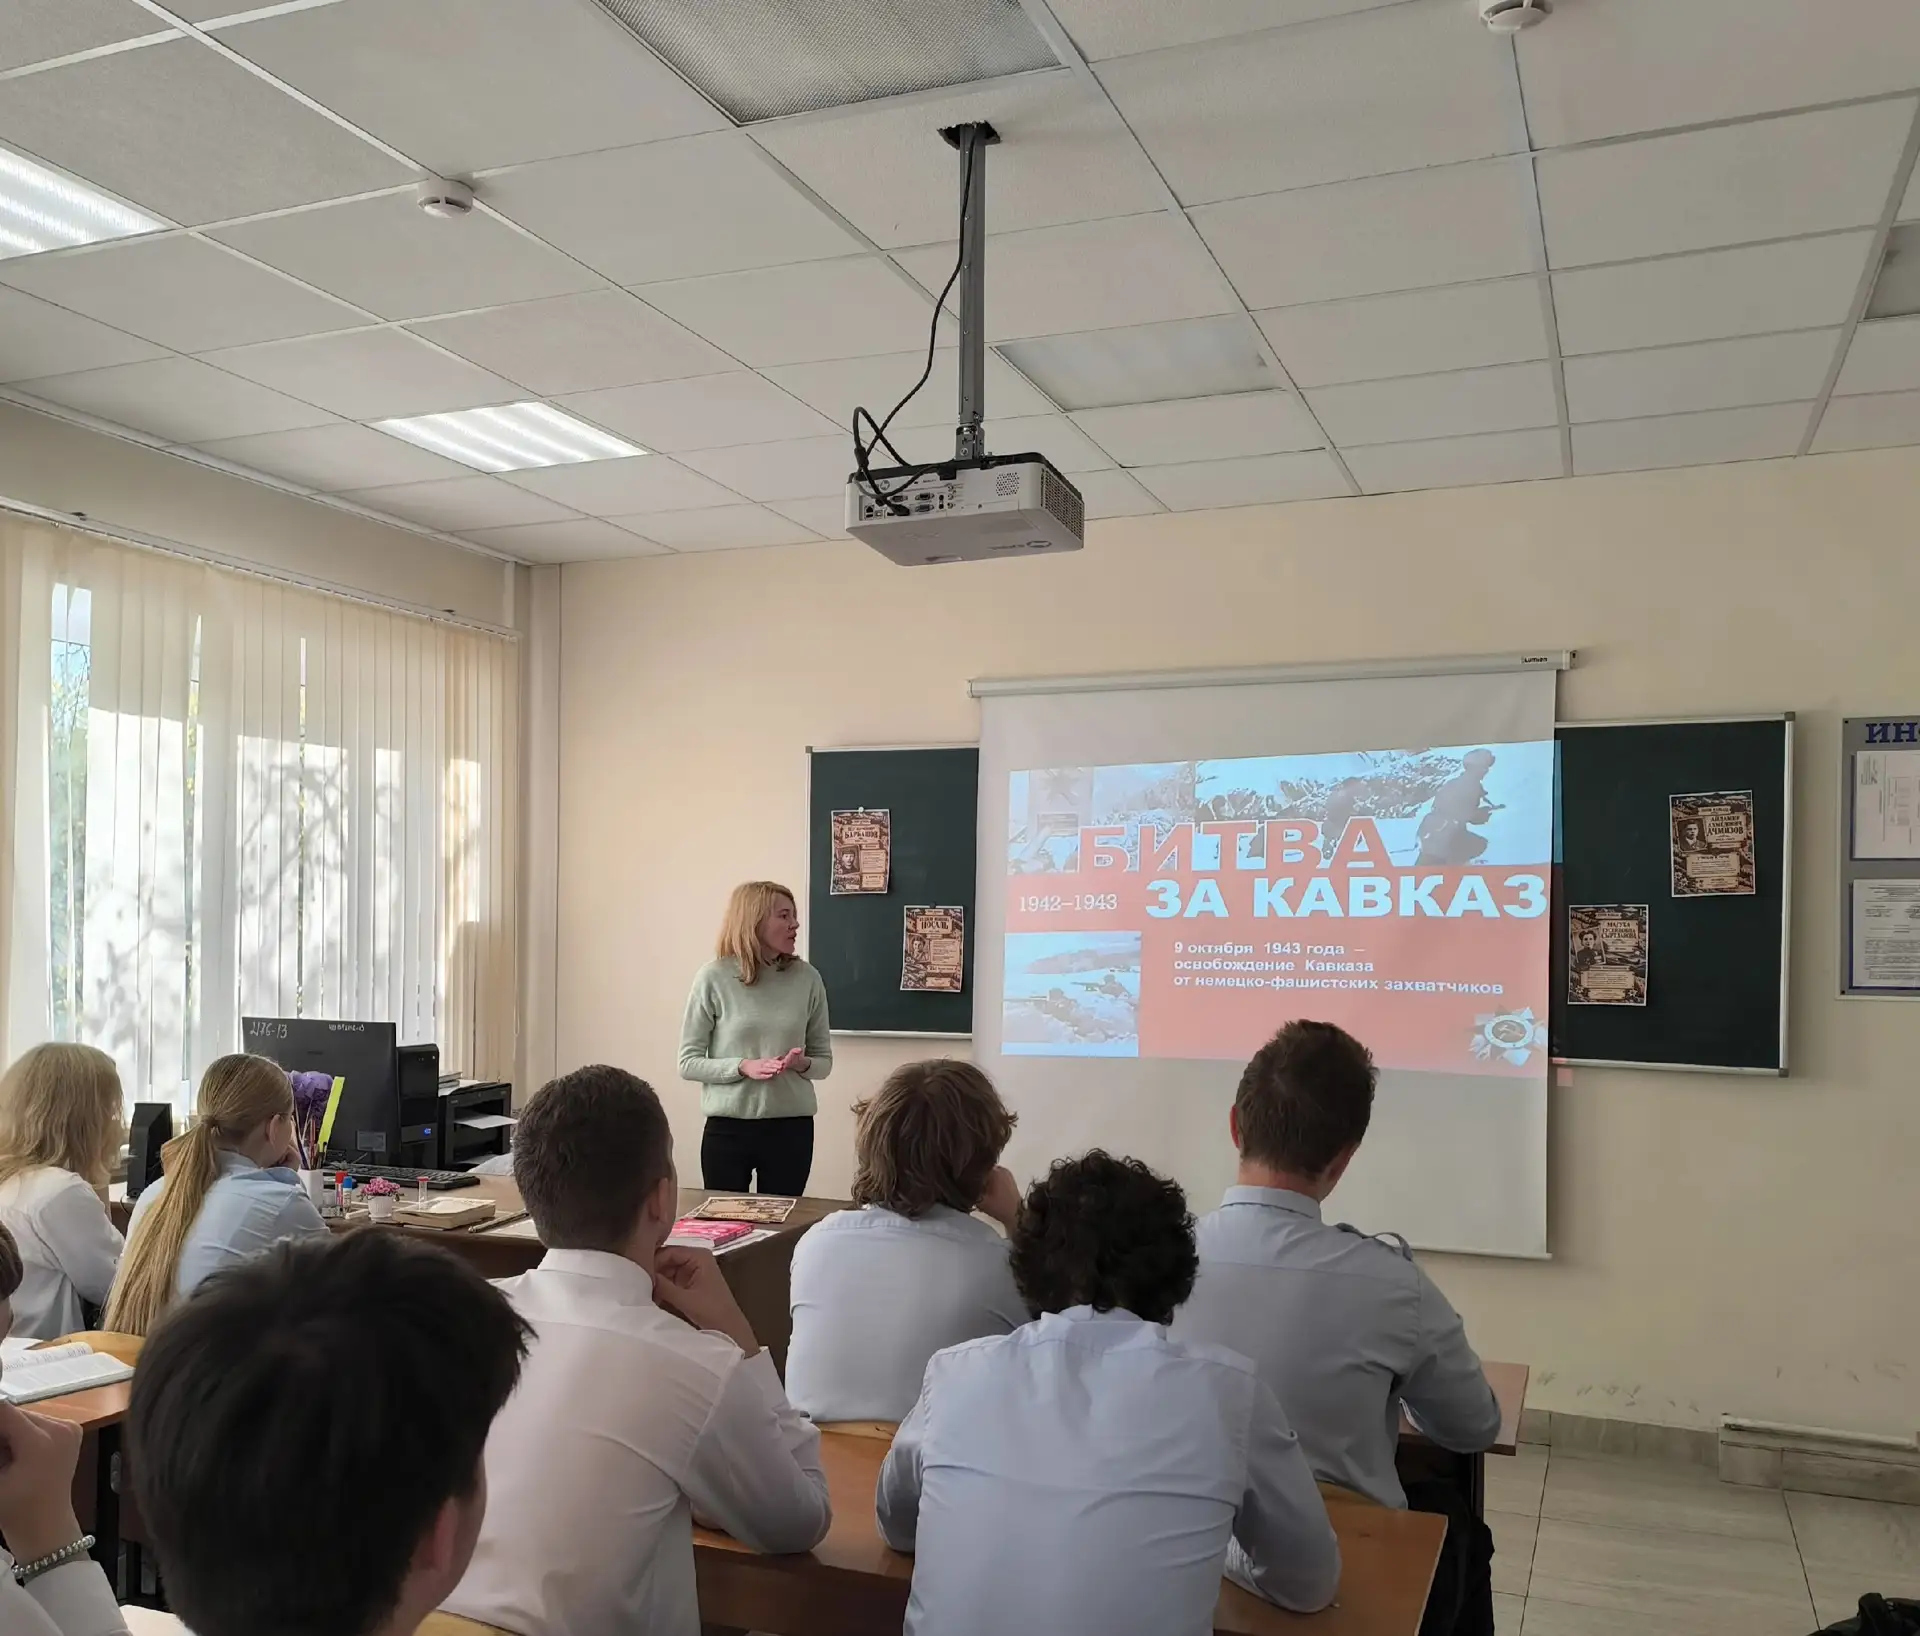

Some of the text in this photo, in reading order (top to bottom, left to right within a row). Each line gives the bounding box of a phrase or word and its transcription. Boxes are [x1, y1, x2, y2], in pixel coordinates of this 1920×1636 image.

[1865, 722, 1920, 743] ИН
[1078, 816, 1394, 873] БИТВА
[1145, 874, 1549, 919] ЗА КАВКАЗ
[1174, 941, 1183, 954] 9
[1187, 941, 1254, 956] октября
[1263, 942, 1301, 954] 1943
[1306, 944, 1345, 956] года
[1174, 958, 1375, 972] освобождение Кавказа
[1173, 976, 1504, 995] от немецко-фашистских захватчиков
